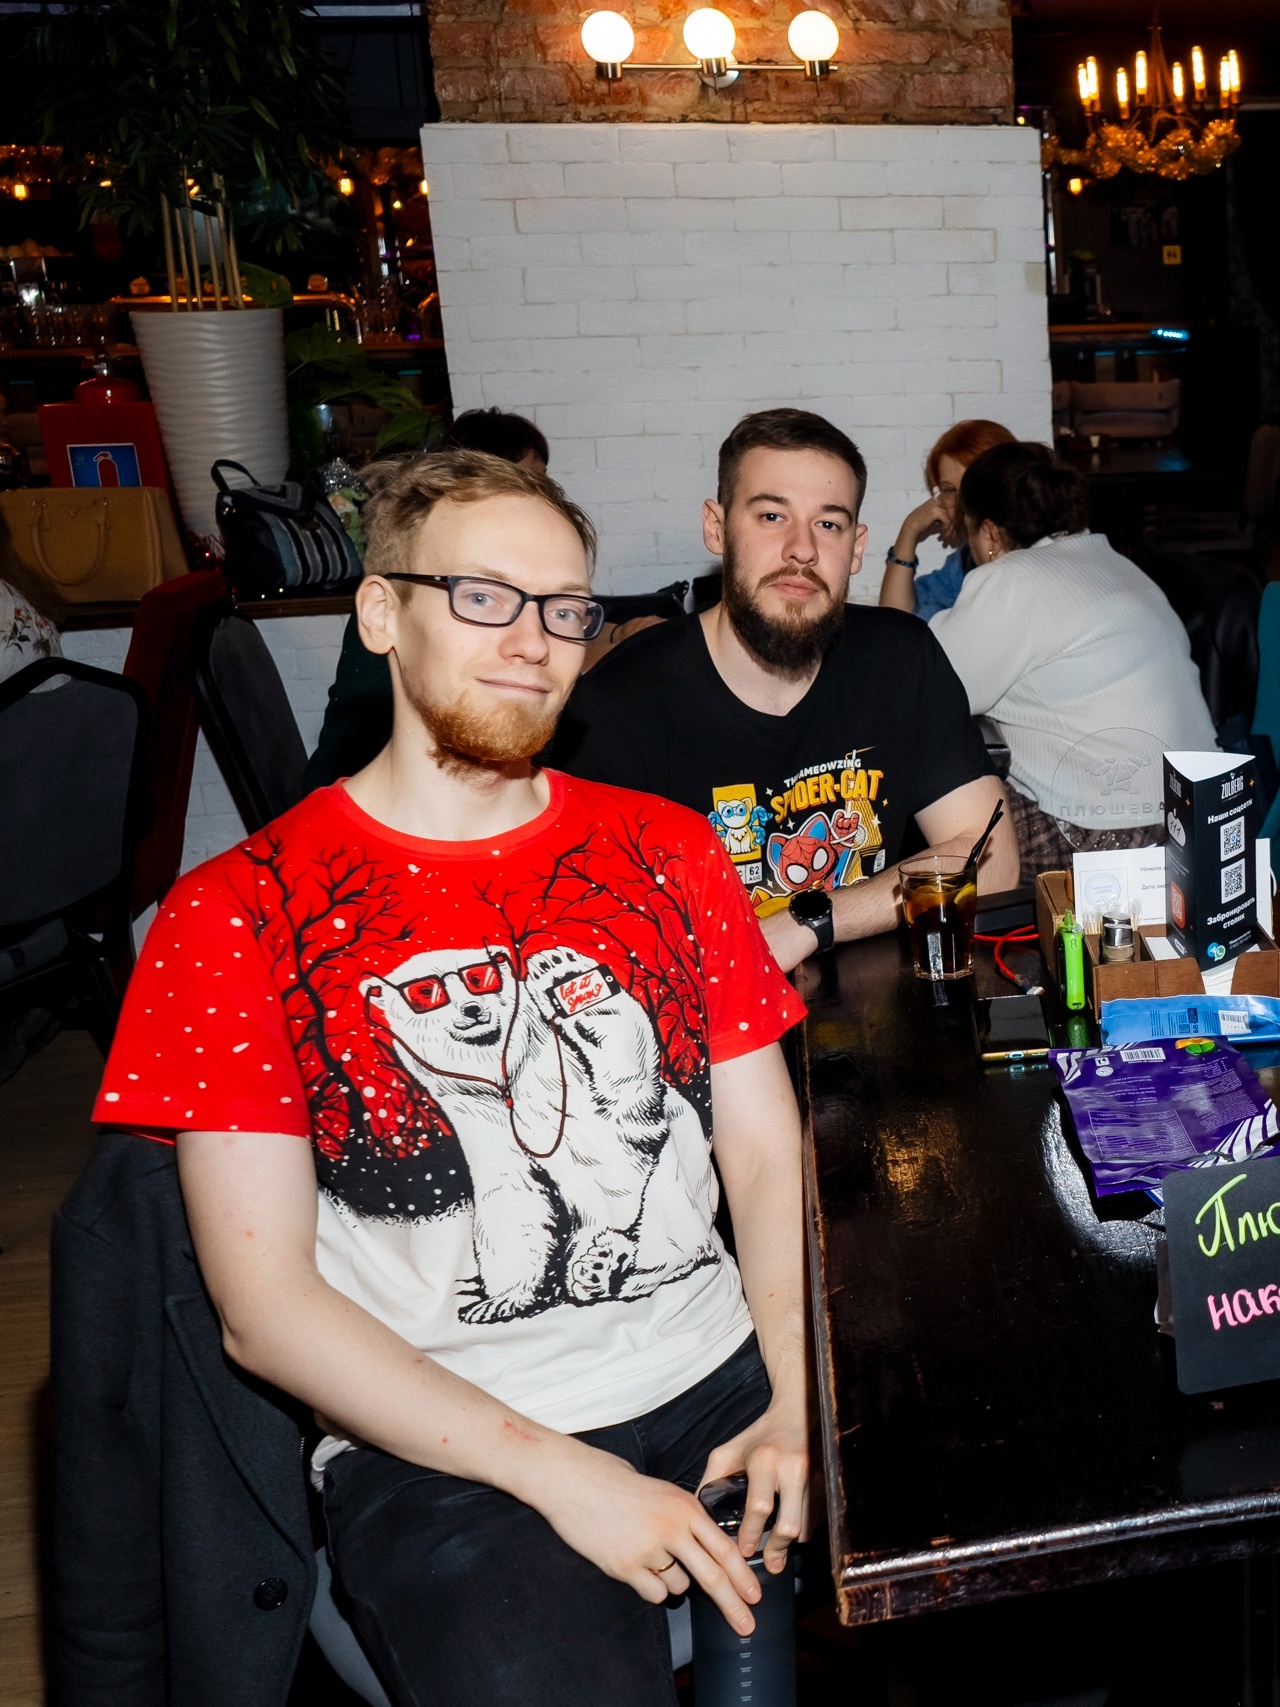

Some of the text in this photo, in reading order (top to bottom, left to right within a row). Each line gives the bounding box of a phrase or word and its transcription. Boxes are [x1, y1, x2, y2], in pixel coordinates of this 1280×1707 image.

[797, 758, 862, 779] AMEOWZING
[770, 768, 884, 823] SPIDER-CAT
[1221, 775, 1244, 800] ZOLBERG
[1207, 798, 1253, 824] Наши соцсети
[1222, 913, 1245, 929] столик
[579, 972, 594, 989] it
